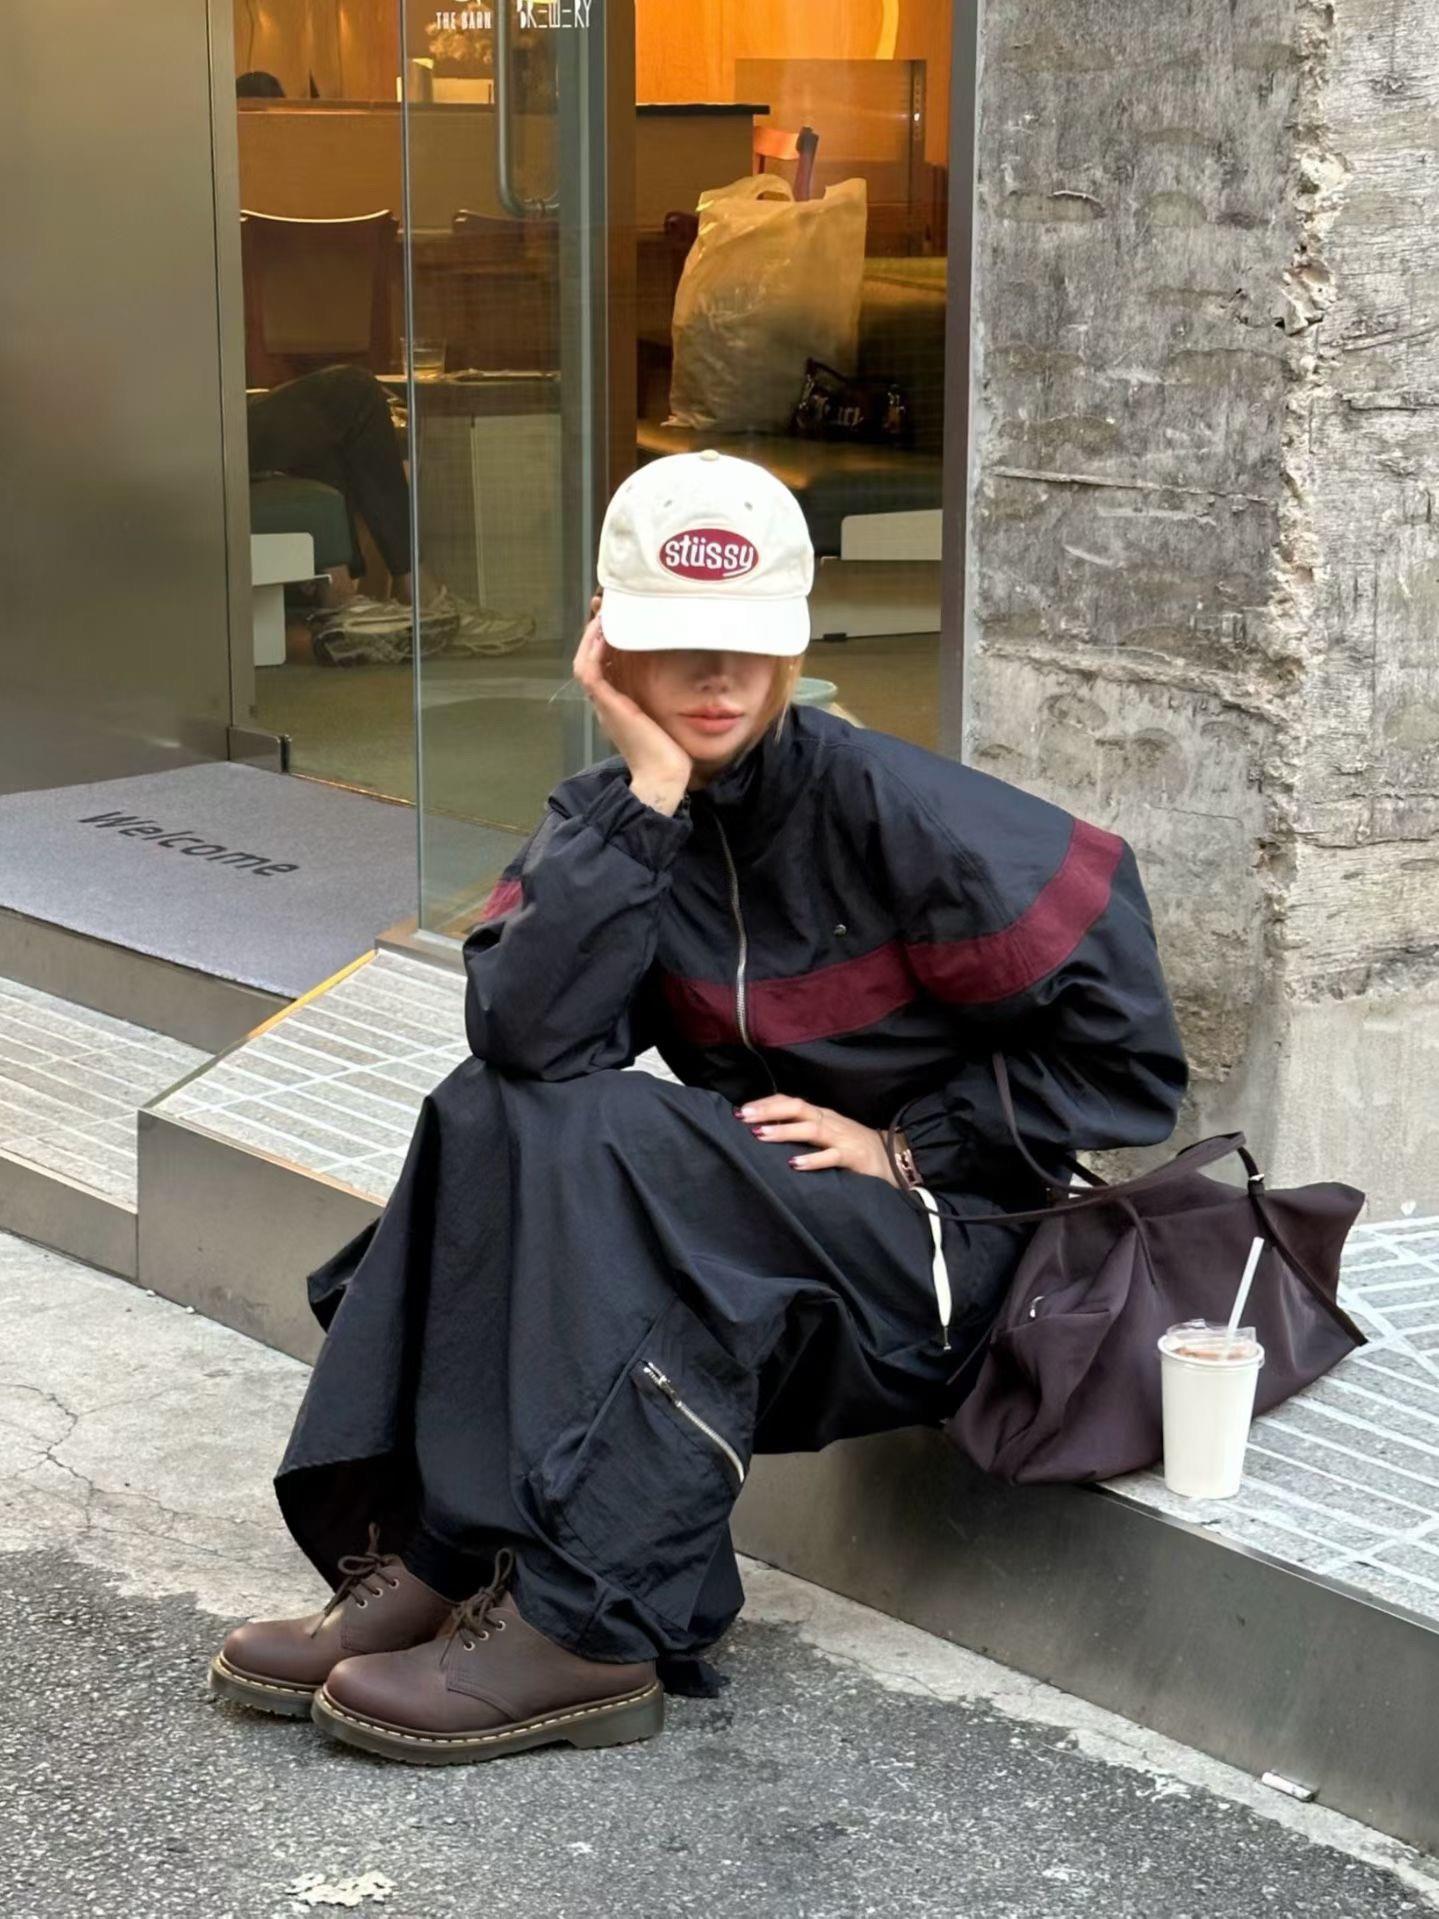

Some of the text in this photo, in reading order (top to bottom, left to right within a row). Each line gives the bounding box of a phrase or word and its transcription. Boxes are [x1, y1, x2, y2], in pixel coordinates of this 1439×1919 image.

[436, 11, 491, 30] THE BARN
[78, 811, 299, 876] Welcome
